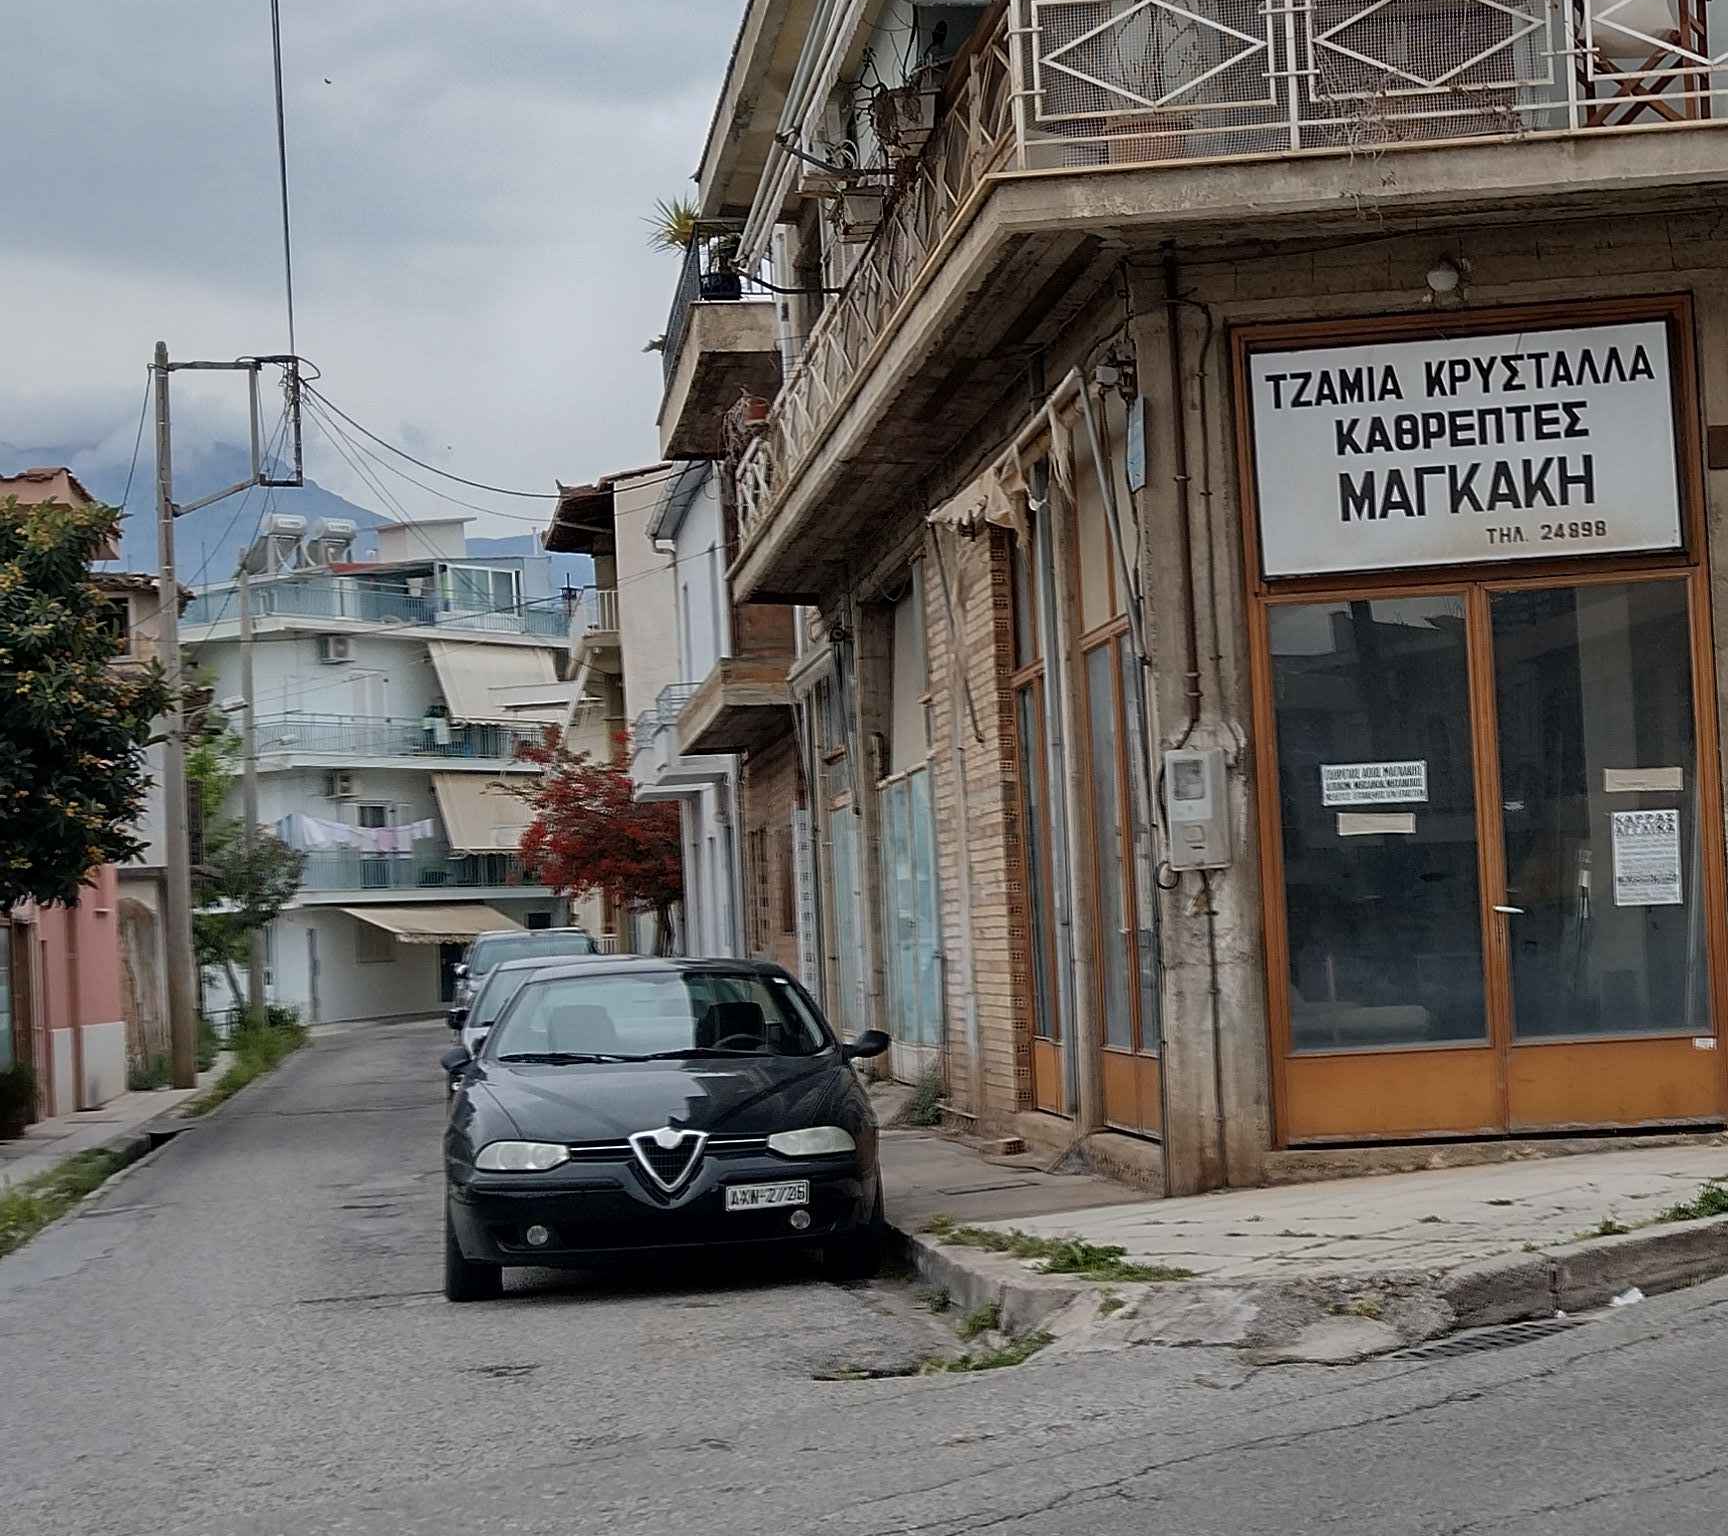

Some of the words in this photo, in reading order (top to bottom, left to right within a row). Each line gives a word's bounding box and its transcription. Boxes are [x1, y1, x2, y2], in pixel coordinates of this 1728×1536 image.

[1264, 364, 1403, 409] ΤΖΑΜΙΑ
[1424, 344, 1656, 398] ΚΡΥΣΤΑΛΛΑ
[1334, 400, 1591, 455] ΚΑΘΡΕΠΤΕΣ
[1337, 453, 1596, 522] ΜΑΓΚΑΚΗ
[1486, 525, 1529, 545] ΤΗΛ.
[1540, 520, 1607, 541] 24898
